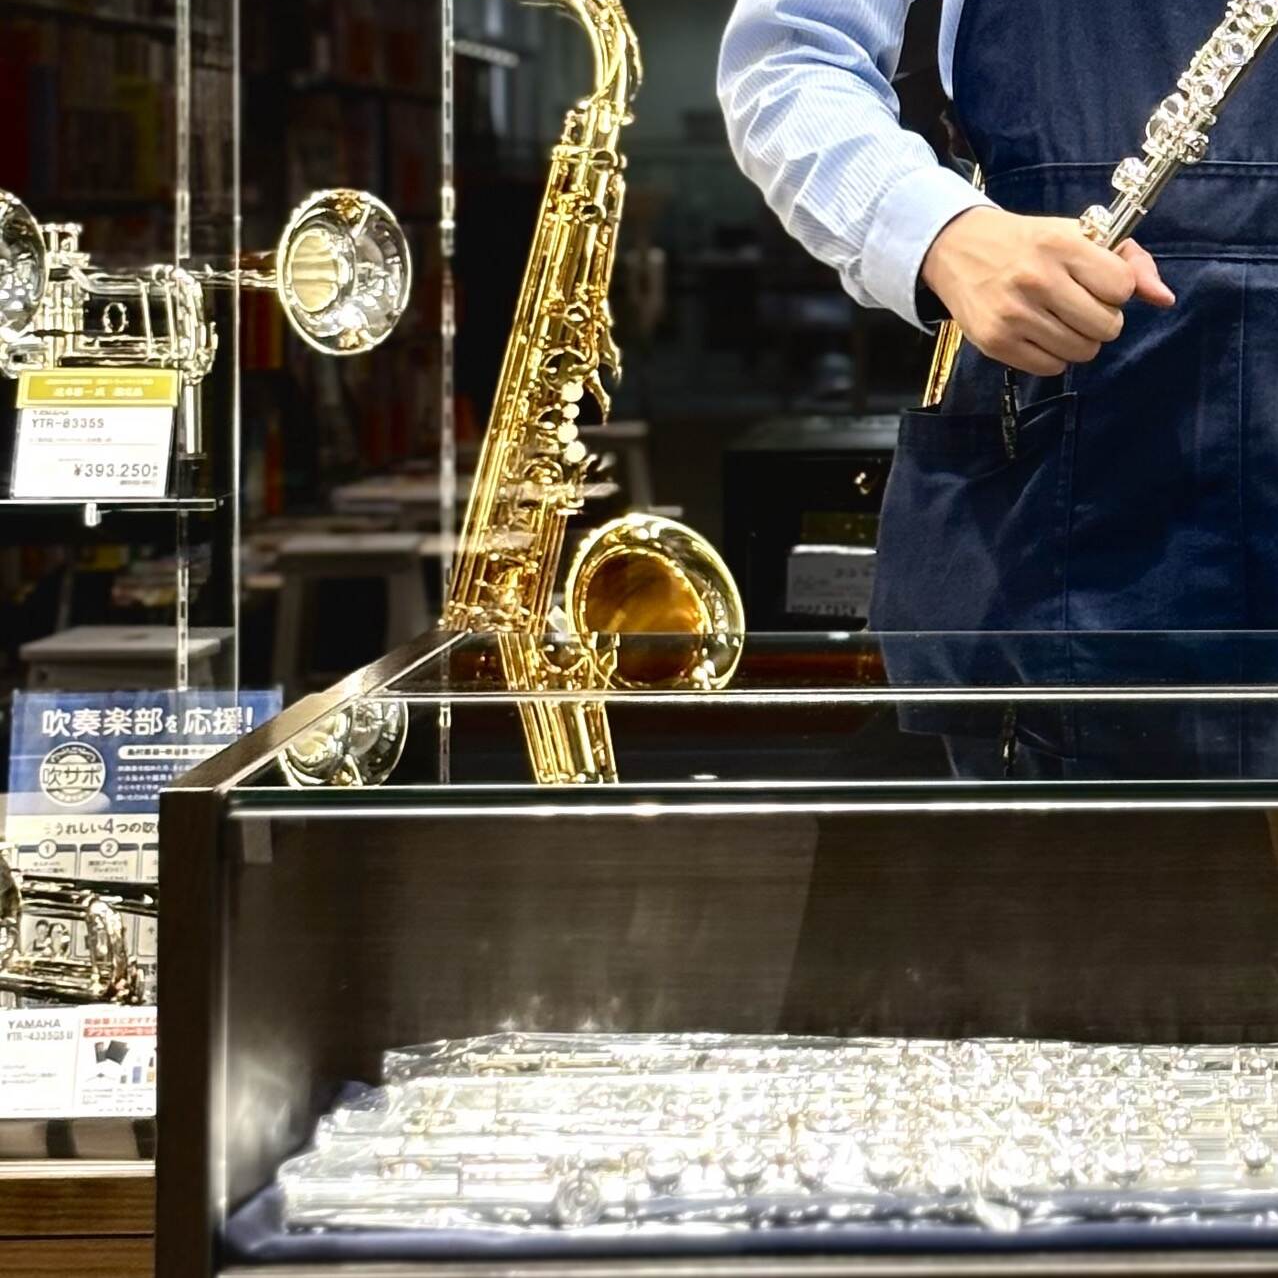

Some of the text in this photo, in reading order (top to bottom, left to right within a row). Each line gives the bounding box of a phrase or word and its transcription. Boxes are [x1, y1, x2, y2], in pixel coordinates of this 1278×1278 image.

[73, 463, 151, 478] ¥393,250
[41, 706, 254, 738] 吹奏楽部を応援!
[8, 1019, 61, 1029] YAMAHA
